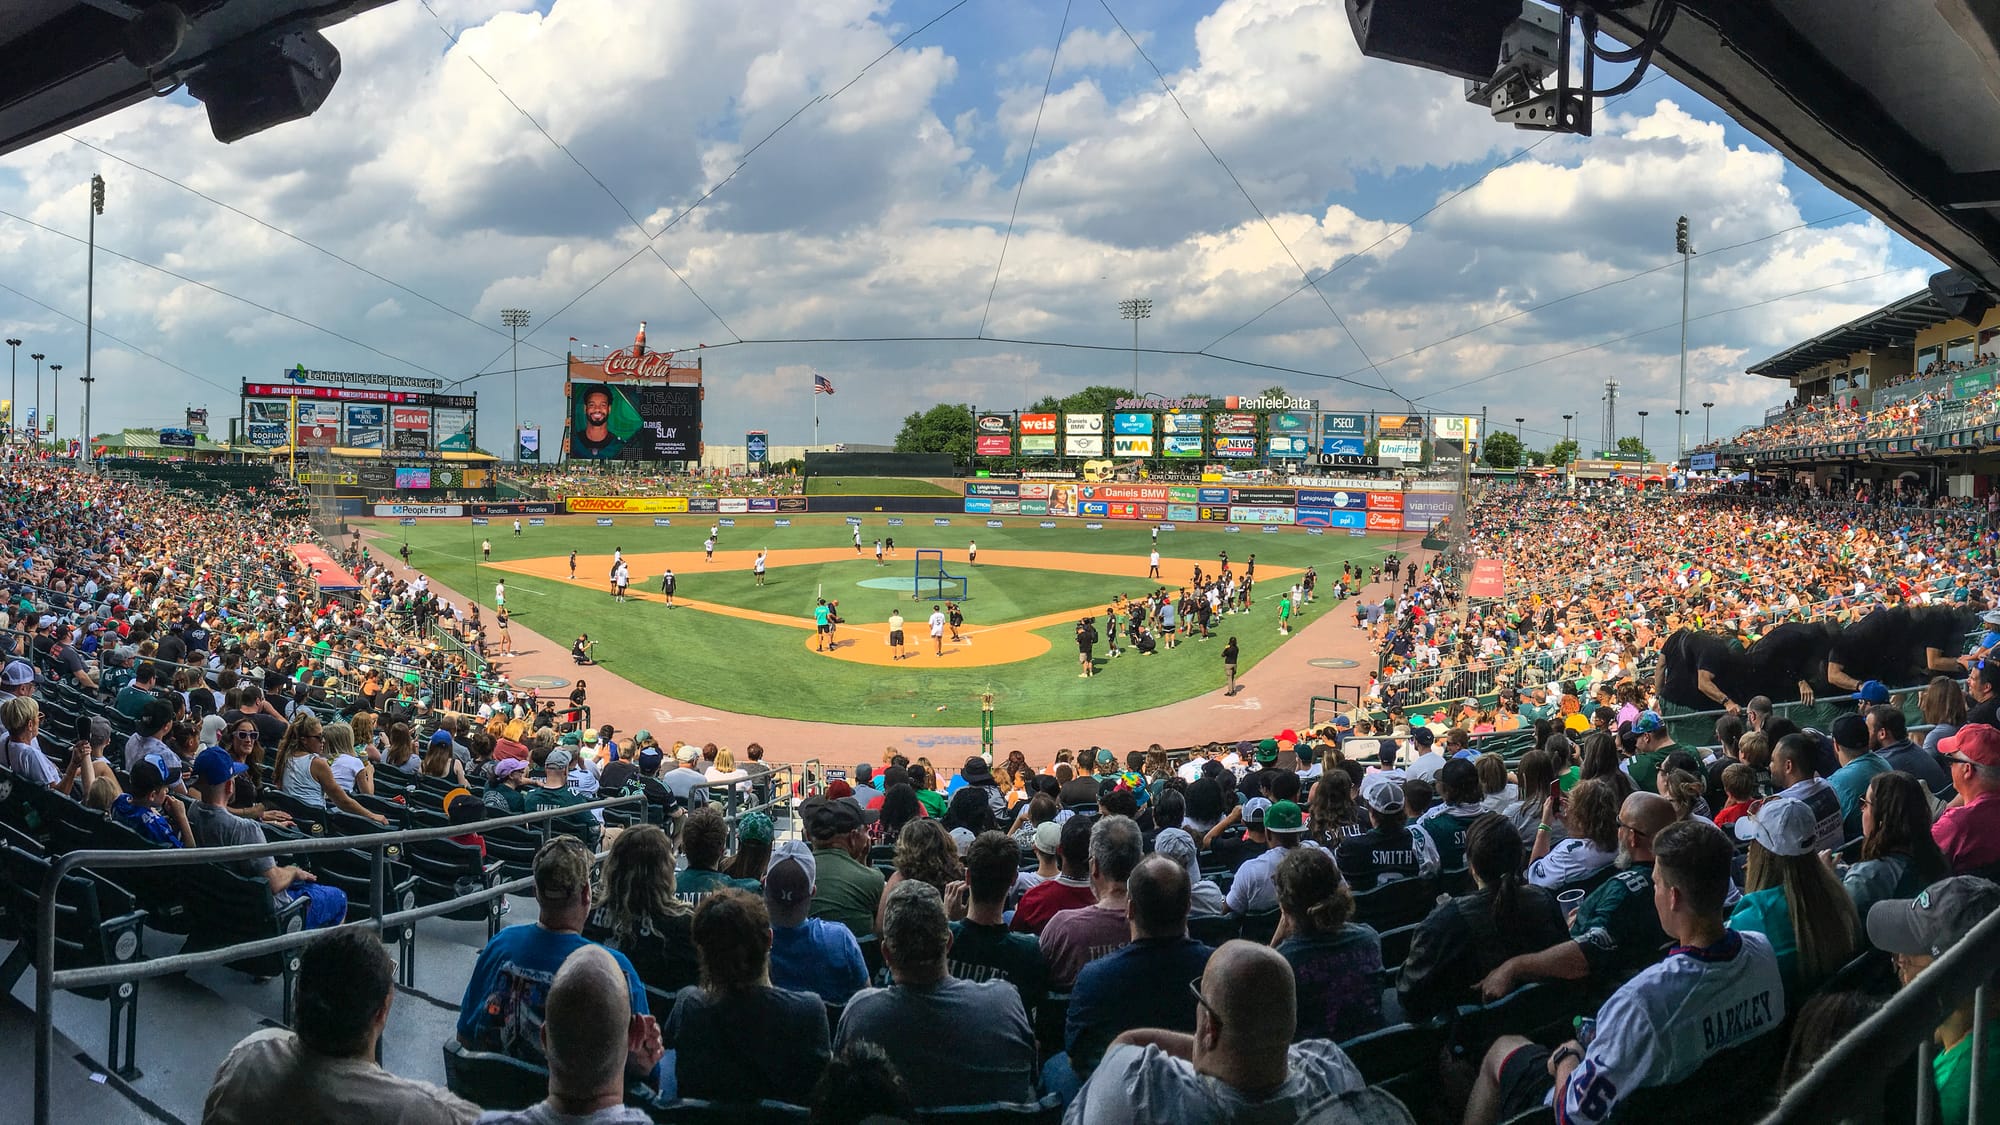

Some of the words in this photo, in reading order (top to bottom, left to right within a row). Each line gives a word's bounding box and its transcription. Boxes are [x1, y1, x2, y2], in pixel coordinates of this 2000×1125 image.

[307, 370, 340, 383] Lehigh
[342, 372, 370, 386] Valley
[372, 374, 401, 385] Health
[403, 378, 440, 388] Network
[643, 391, 689, 403] TEAM
[1239, 396, 1311, 409] PenTeleData
[640, 404, 692, 416] SMITH
[396, 414, 428, 424] GIANT
[1021, 418, 1055, 430] weis
[1333, 418, 1354, 428] PSECU
[657, 428, 677, 438] SLAY
[1116, 441, 1148, 451] WM
[1381, 444, 1419, 454] UniFirst
[1338, 456, 1373, 464] KLYR
[1106, 488, 1138, 497] Daniels
[1141, 489, 1165, 497] BMW
[403, 506, 428, 515] People
[430, 506, 446, 514] First
[1409, 500, 1453, 511] viamedia
[1370, 513, 1400, 526] Friendly's
[1372, 850, 1413, 865] SMITH
[1702, 990, 1773, 1050] BARKLEY
